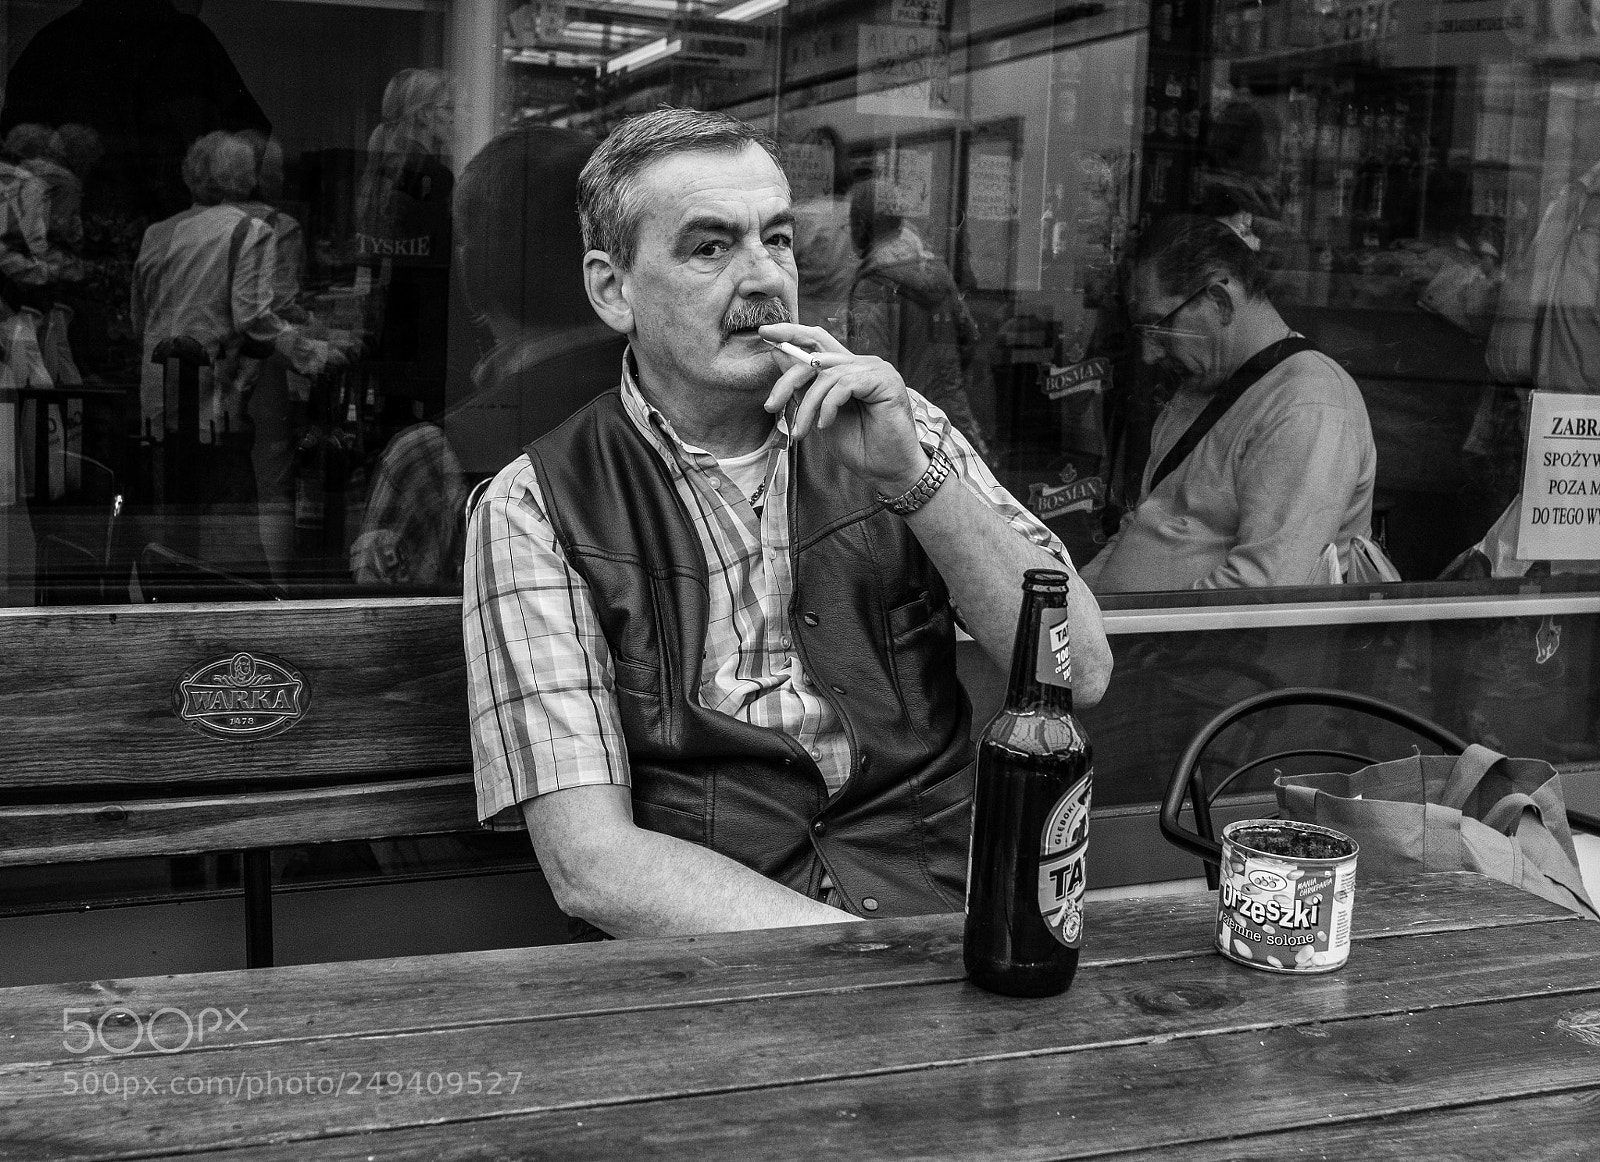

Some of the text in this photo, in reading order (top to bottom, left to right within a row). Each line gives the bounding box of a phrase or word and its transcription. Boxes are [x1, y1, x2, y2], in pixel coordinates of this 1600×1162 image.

[355, 233, 430, 256] TYSKIE
[1045, 362, 1105, 391] BOSMAN
[1551, 416, 1600, 437] ZABR
[1037, 482, 1097, 511] BOSMAN
[1548, 479, 1587, 496] POZA
[1532, 507, 1550, 525] DO
[1553, 507, 1584, 525] TEGO
[190, 689, 291, 711] WARKA
[229, 717, 255, 726] 1478
[1266, 934, 1315, 946] solone
